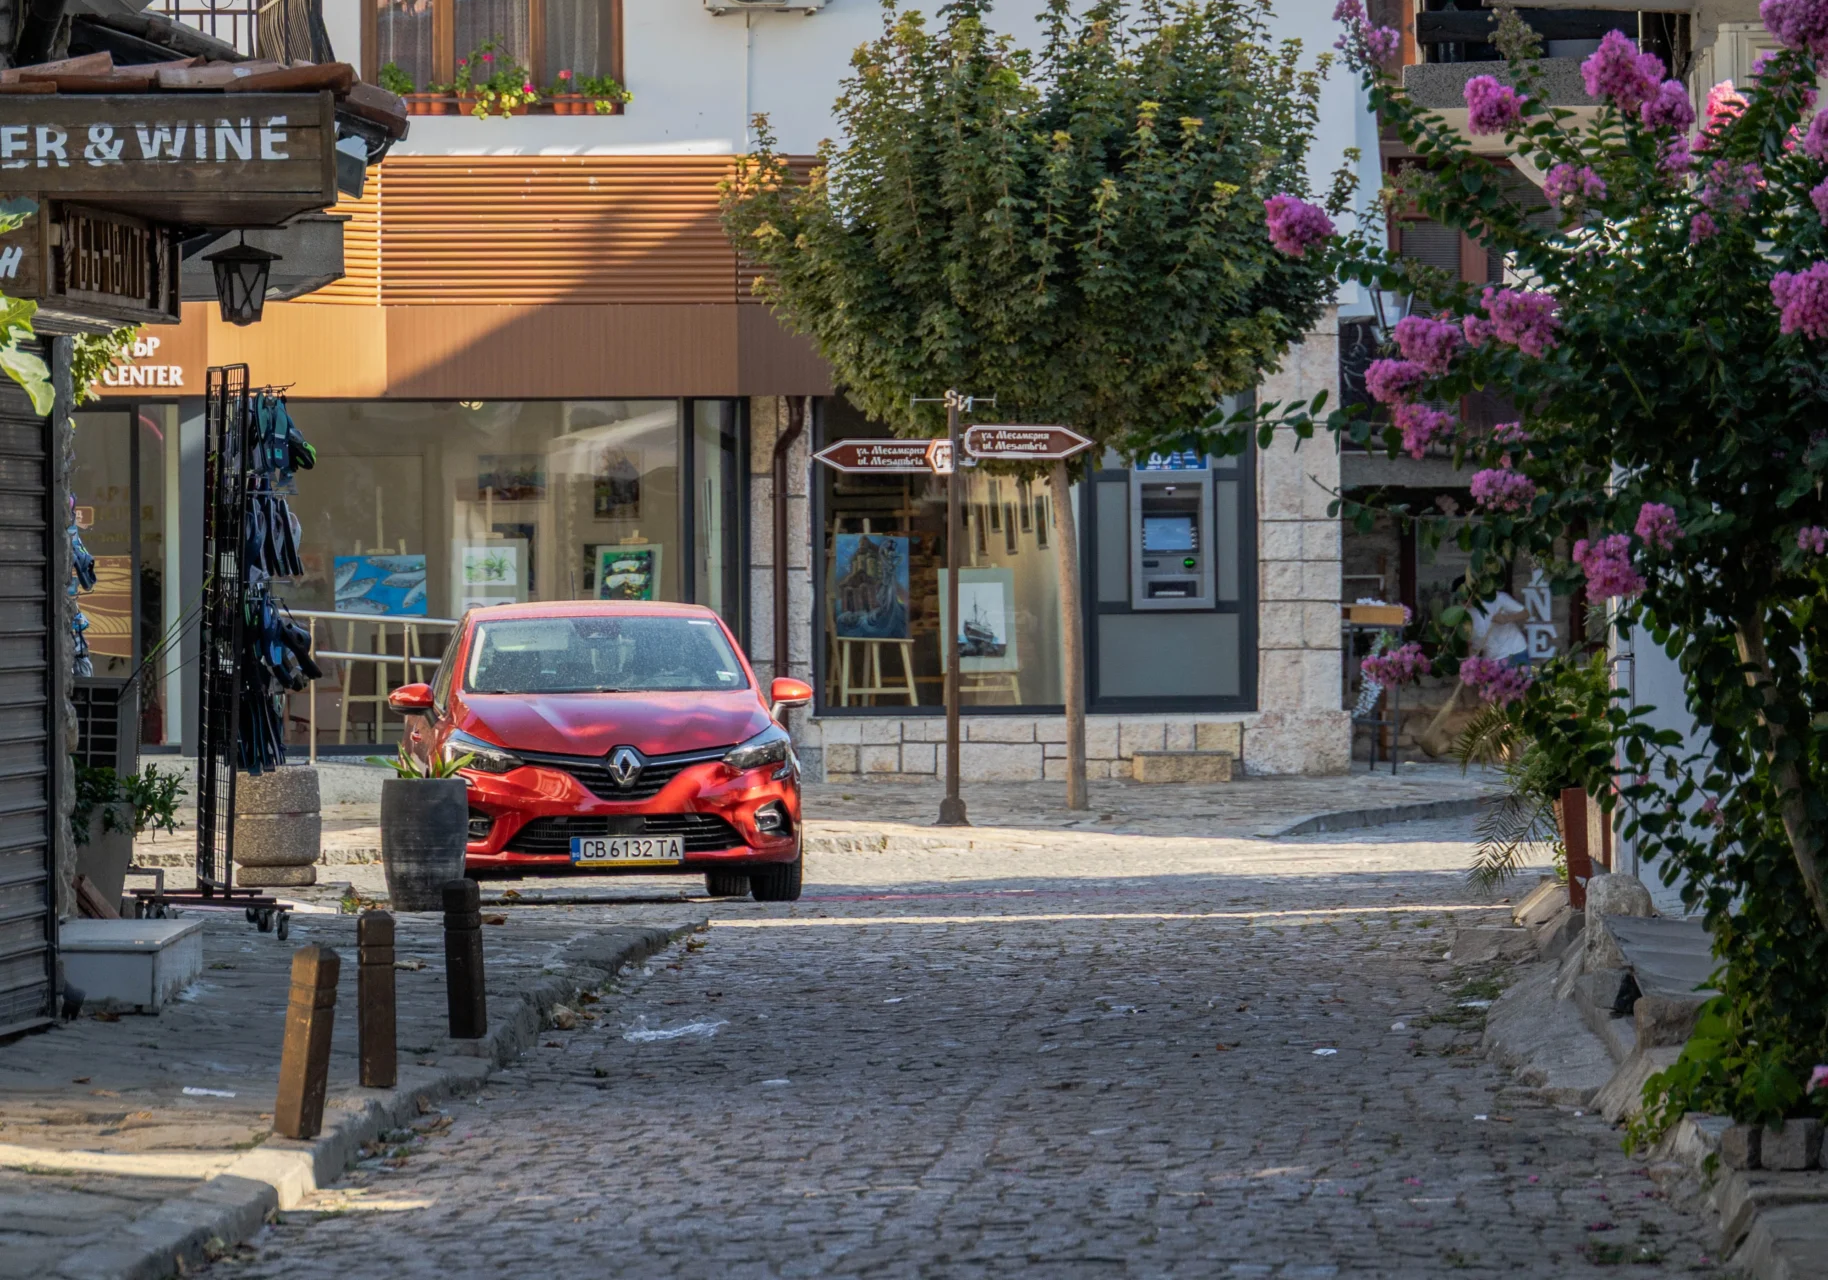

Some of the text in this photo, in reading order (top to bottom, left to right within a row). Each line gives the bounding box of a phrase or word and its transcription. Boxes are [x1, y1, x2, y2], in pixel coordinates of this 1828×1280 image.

[84, 122, 124, 167] &
[136, 116, 290, 164] WINE
[103, 365, 184, 387] CENTER
